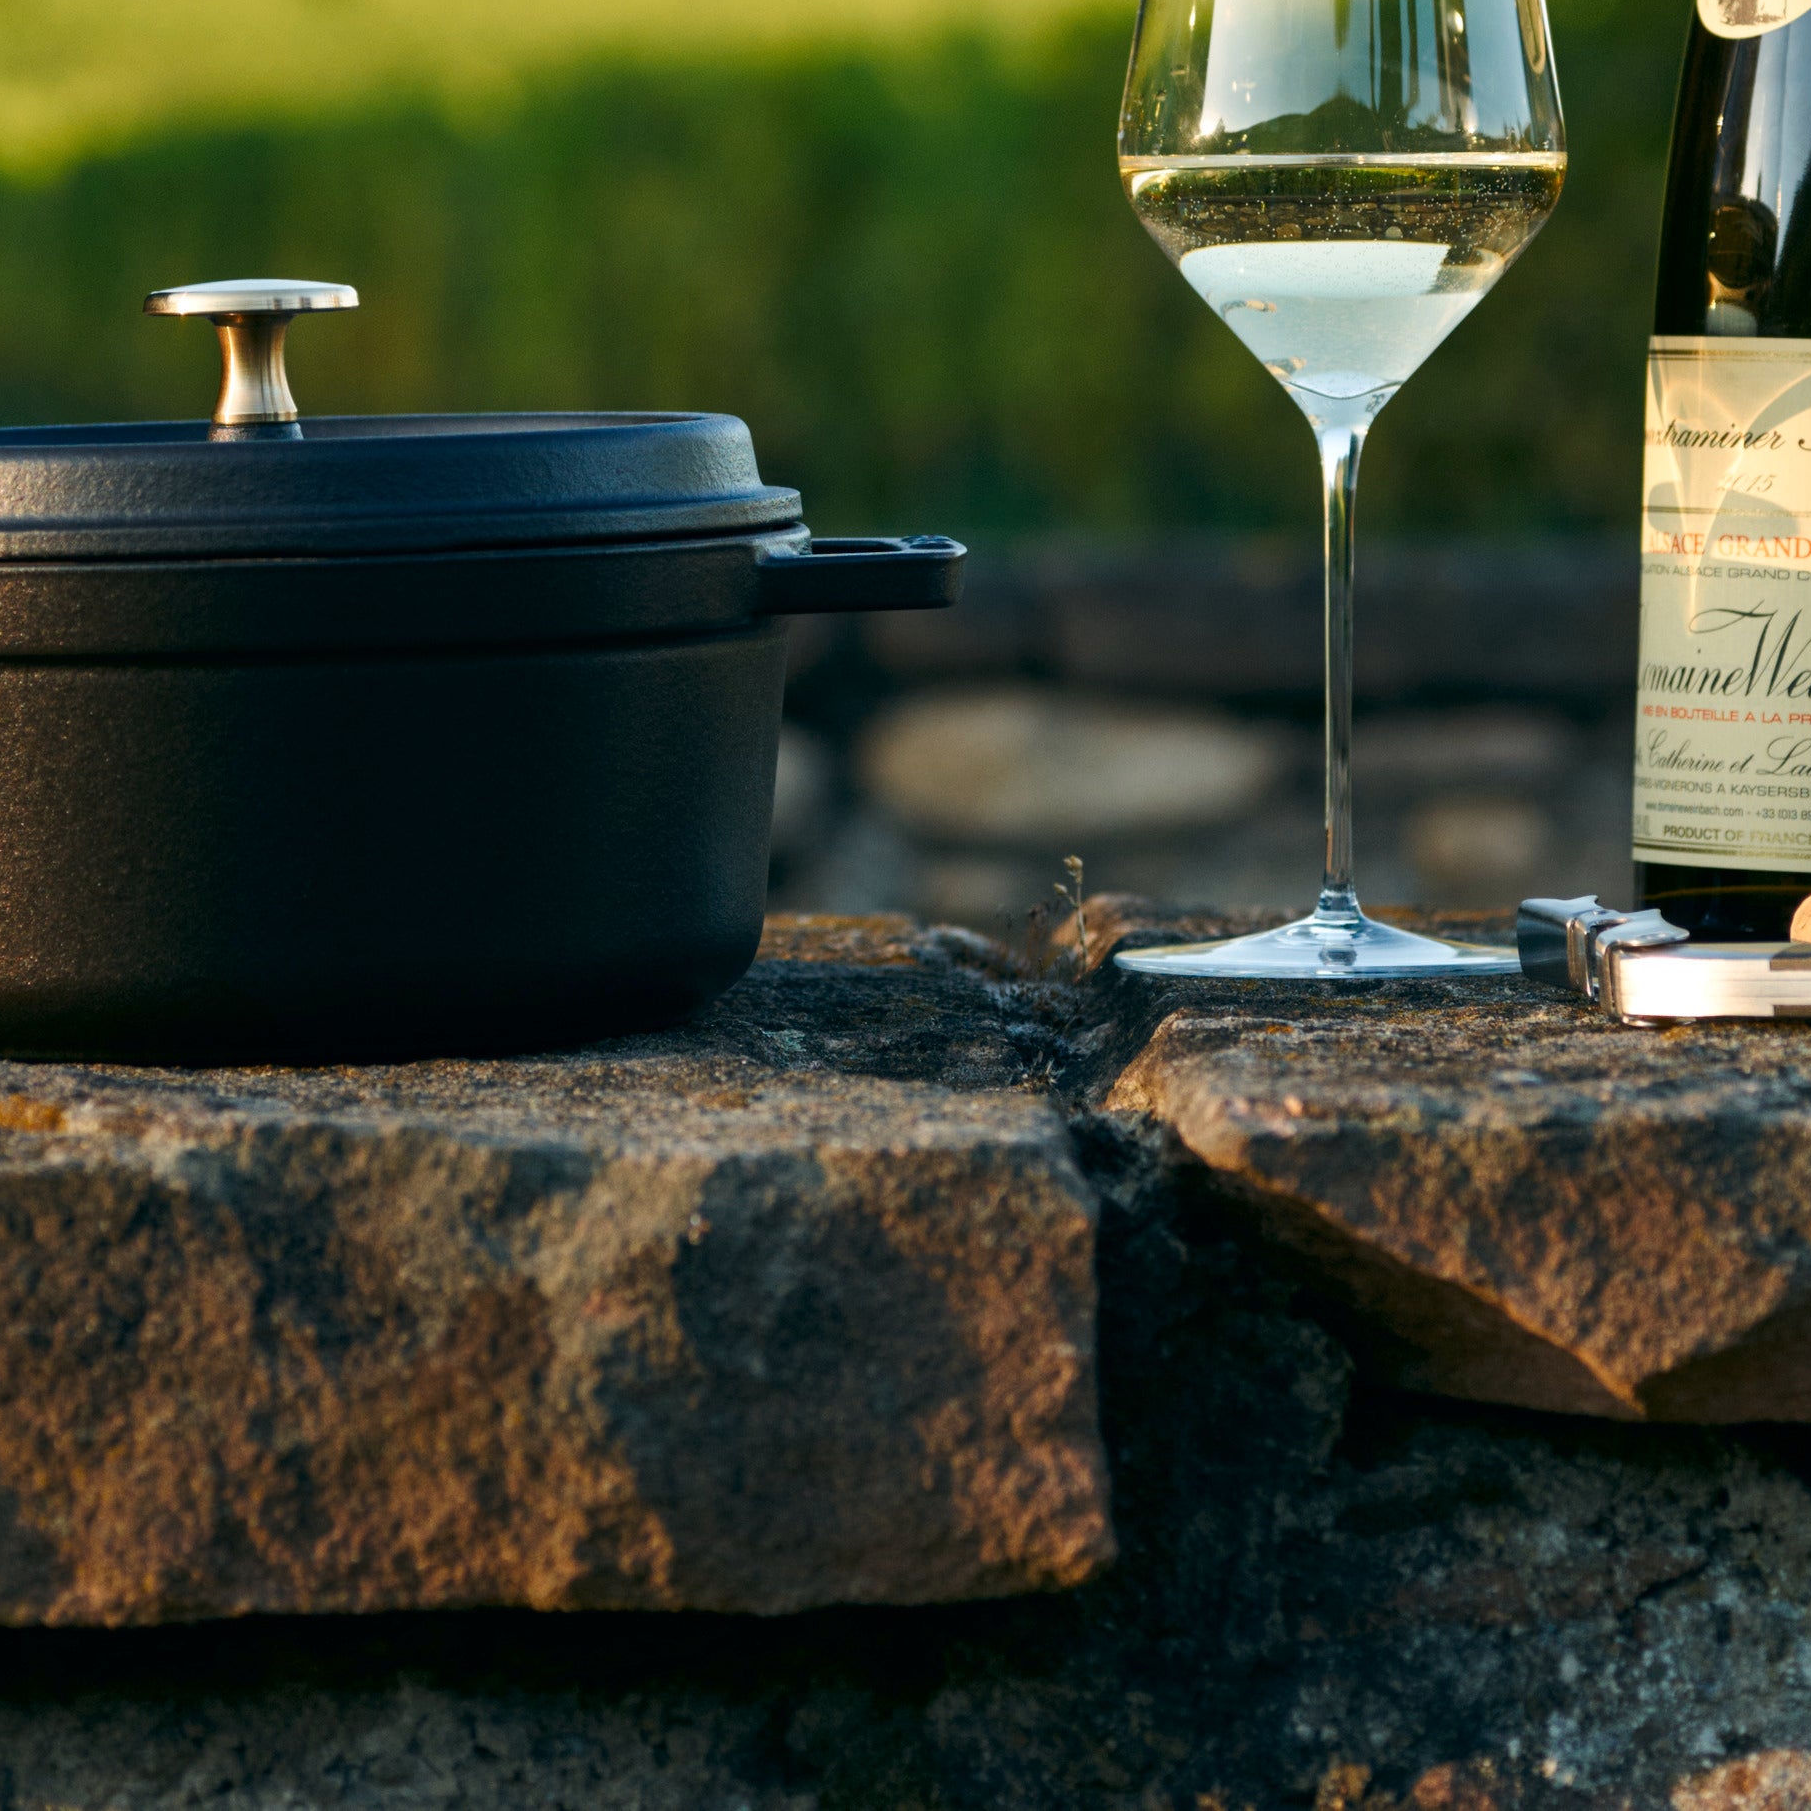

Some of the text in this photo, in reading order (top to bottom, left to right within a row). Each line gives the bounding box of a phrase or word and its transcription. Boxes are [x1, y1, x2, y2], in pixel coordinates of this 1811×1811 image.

[1727, 566, 1790, 581] GRAND
[1671, 707, 1739, 722] BOUTEILLE
[1745, 711, 1757, 723] A
[1762, 712, 1782, 724] LA
[1648, 728, 1725, 772] Catherine
[1730, 754, 1755, 773] et
[1717, 783, 1726, 794] A
[1755, 808, 1775, 820] +33
[1663, 825, 1721, 841] PRODUCT
[1725, 829, 1745, 841] OF
